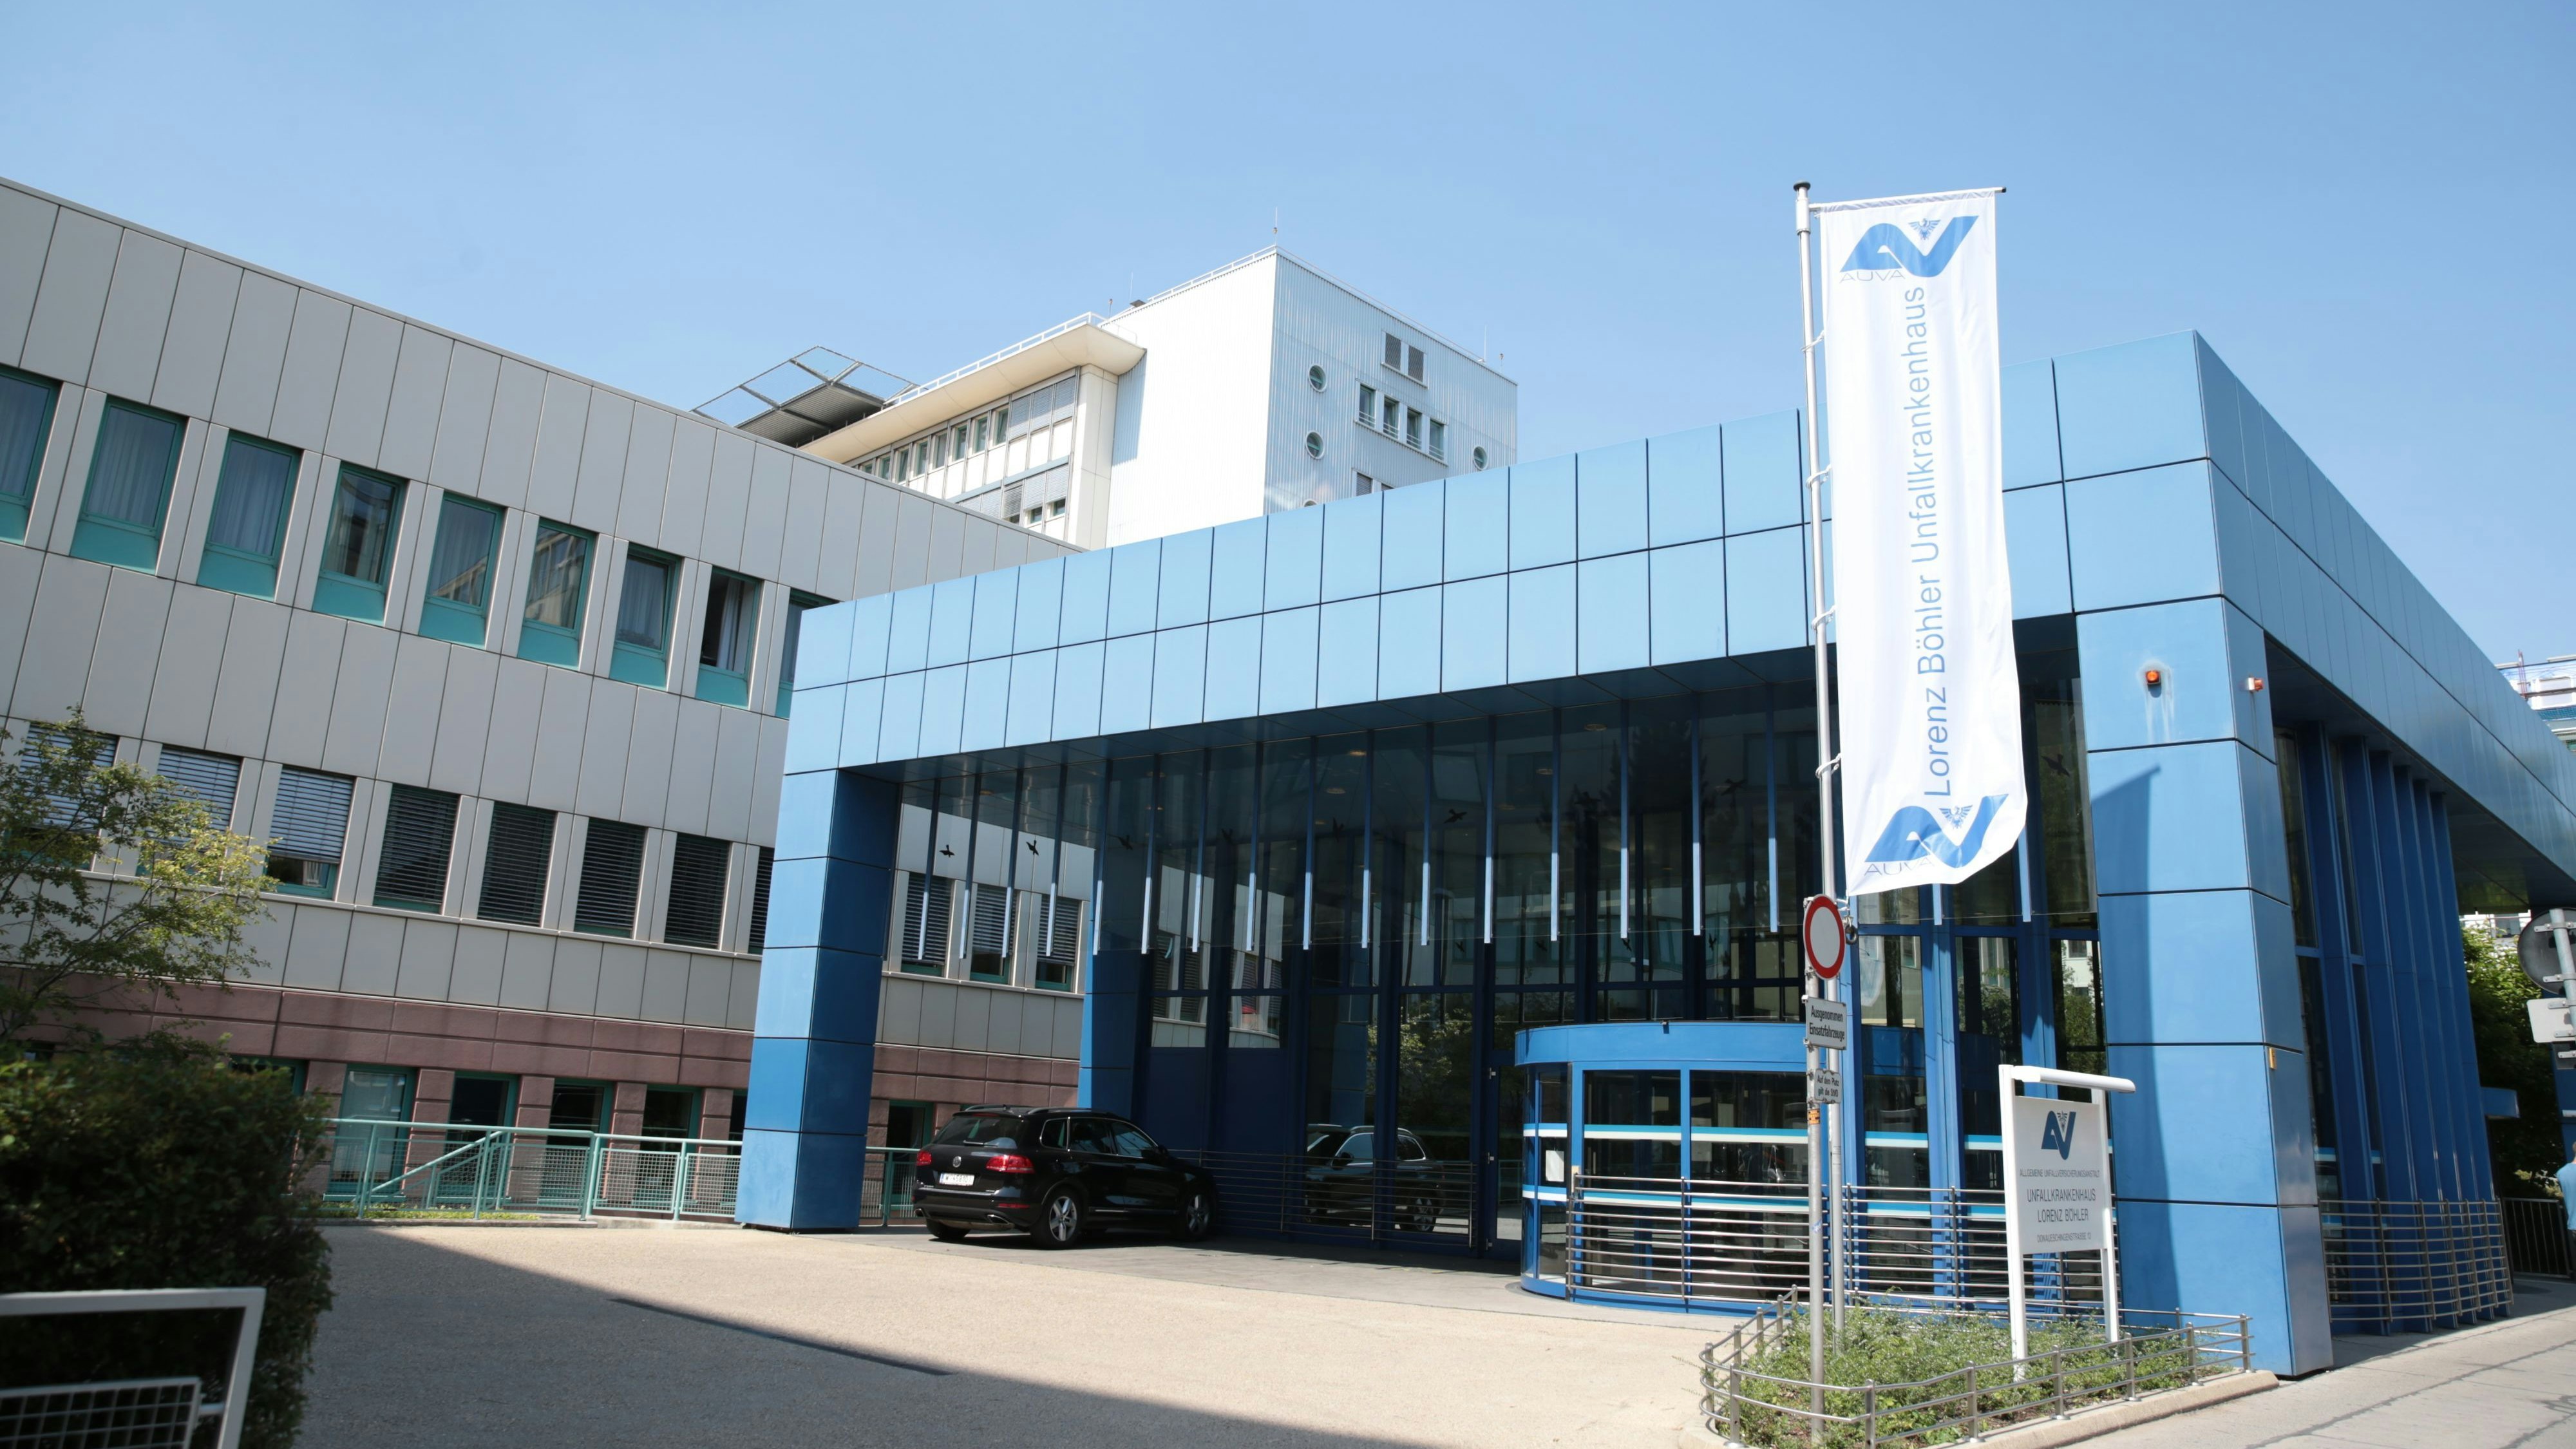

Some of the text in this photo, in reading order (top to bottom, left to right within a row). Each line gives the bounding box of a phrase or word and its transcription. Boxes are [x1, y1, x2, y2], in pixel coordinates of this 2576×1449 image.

[1839, 269, 1906, 283] AUVA
[1900, 287, 1951, 796] Lorenz Böhler Unfallkrankenhaus
[1864, 857, 1935, 876] AUVA
[1811, 1005, 1843, 1022] Ausgenommen
[1810, 1022, 1844, 1042] Einsatzfahrzeuge
[2020, 1169, 2043, 1177] ALLGEMEINE
[2027, 1188, 2096, 1202] UNFALLKRANKENHAUS
[2037, 1208, 2089, 1222] LORENZ BÖHLER
